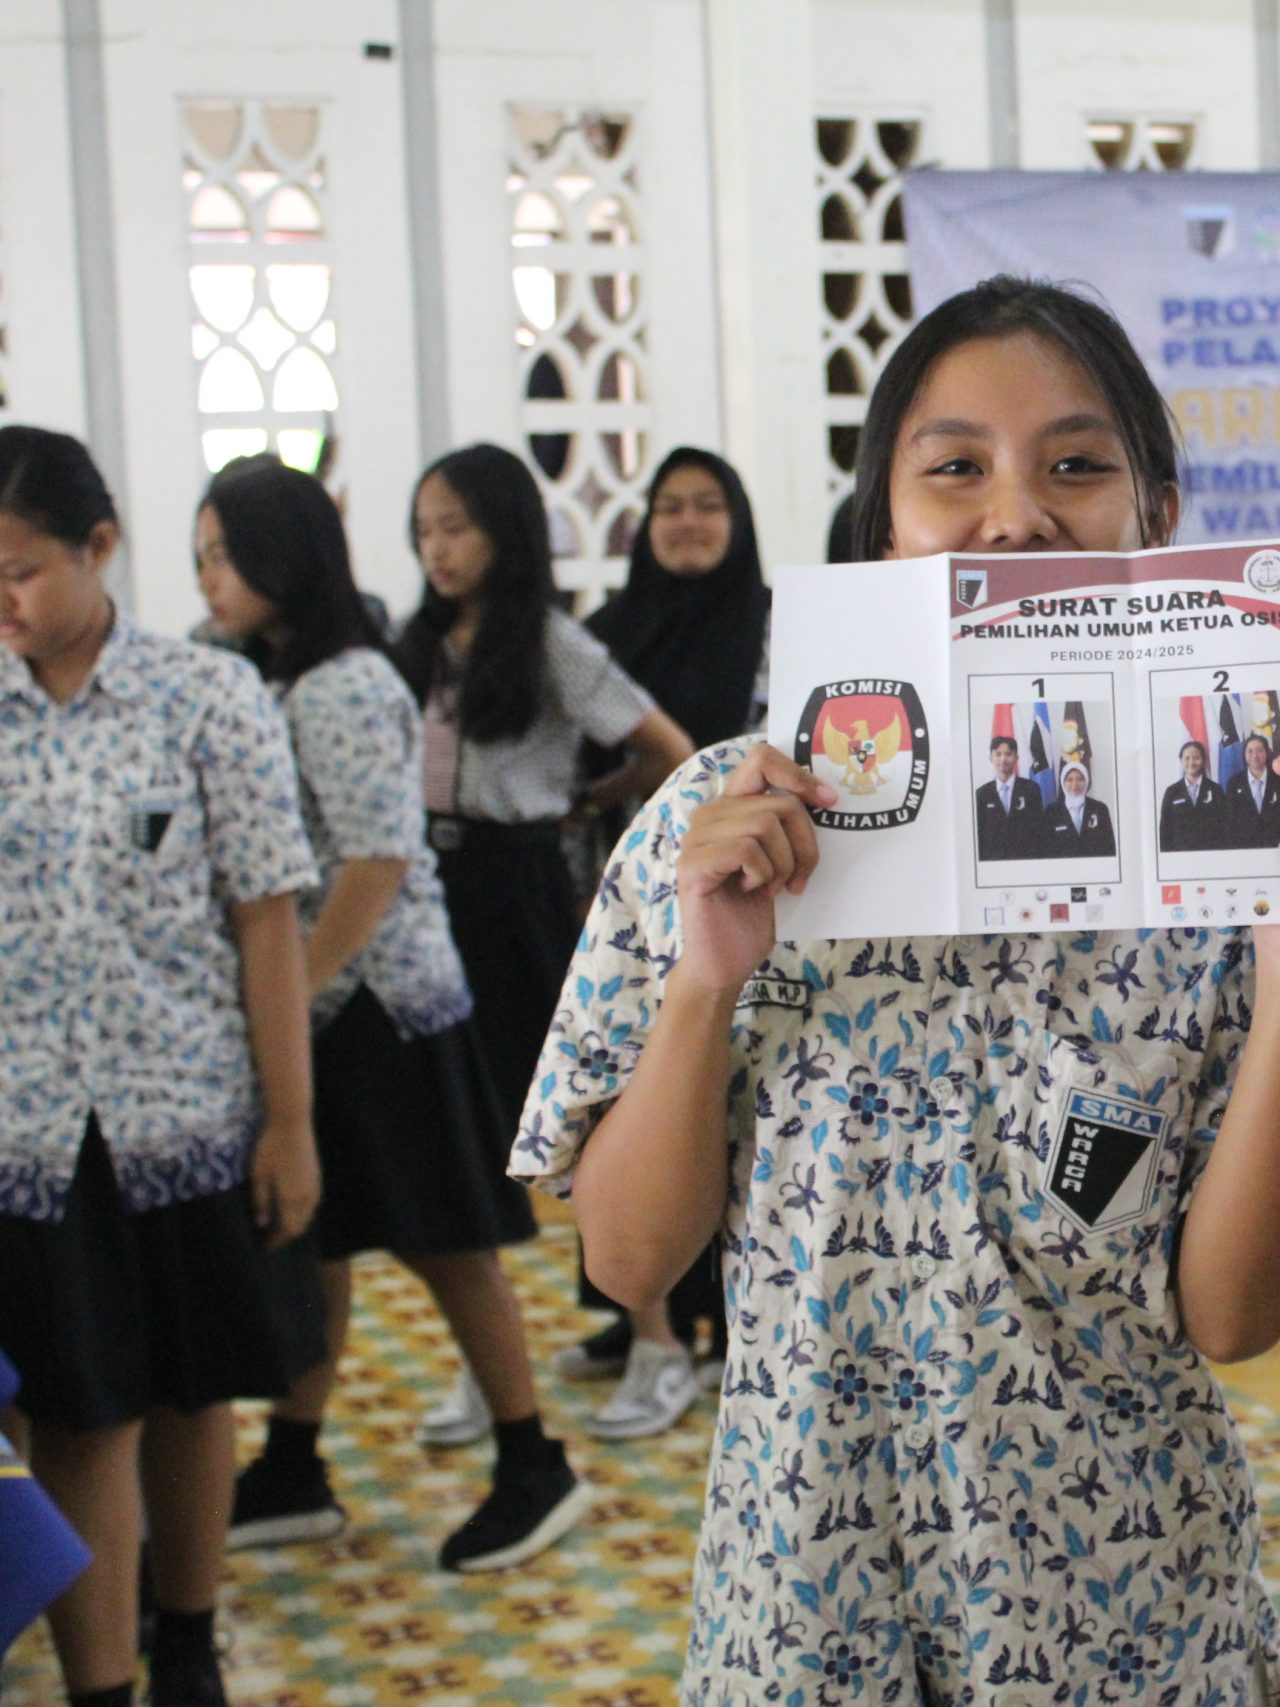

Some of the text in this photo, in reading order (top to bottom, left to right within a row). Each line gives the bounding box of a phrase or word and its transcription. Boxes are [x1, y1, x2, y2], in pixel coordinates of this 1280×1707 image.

[1018, 589, 1227, 618] SURAT SUARA
[960, 623, 1080, 639] PEMILIHAN
[1087, 620, 1153, 638] UMUM
[1160, 613, 1234, 633] KETUA
[1050, 644, 1195, 662] PERIODE 2024/2025
[825, 680, 903, 698] KOMISI
[1031, 677, 1046, 699] 1
[1212, 670, 1231, 693] 2
[896, 759, 927, 823] UMUM
[1079, 1099, 1152, 1131] SMA
[1060, 1122, 1100, 1193] WARGA
